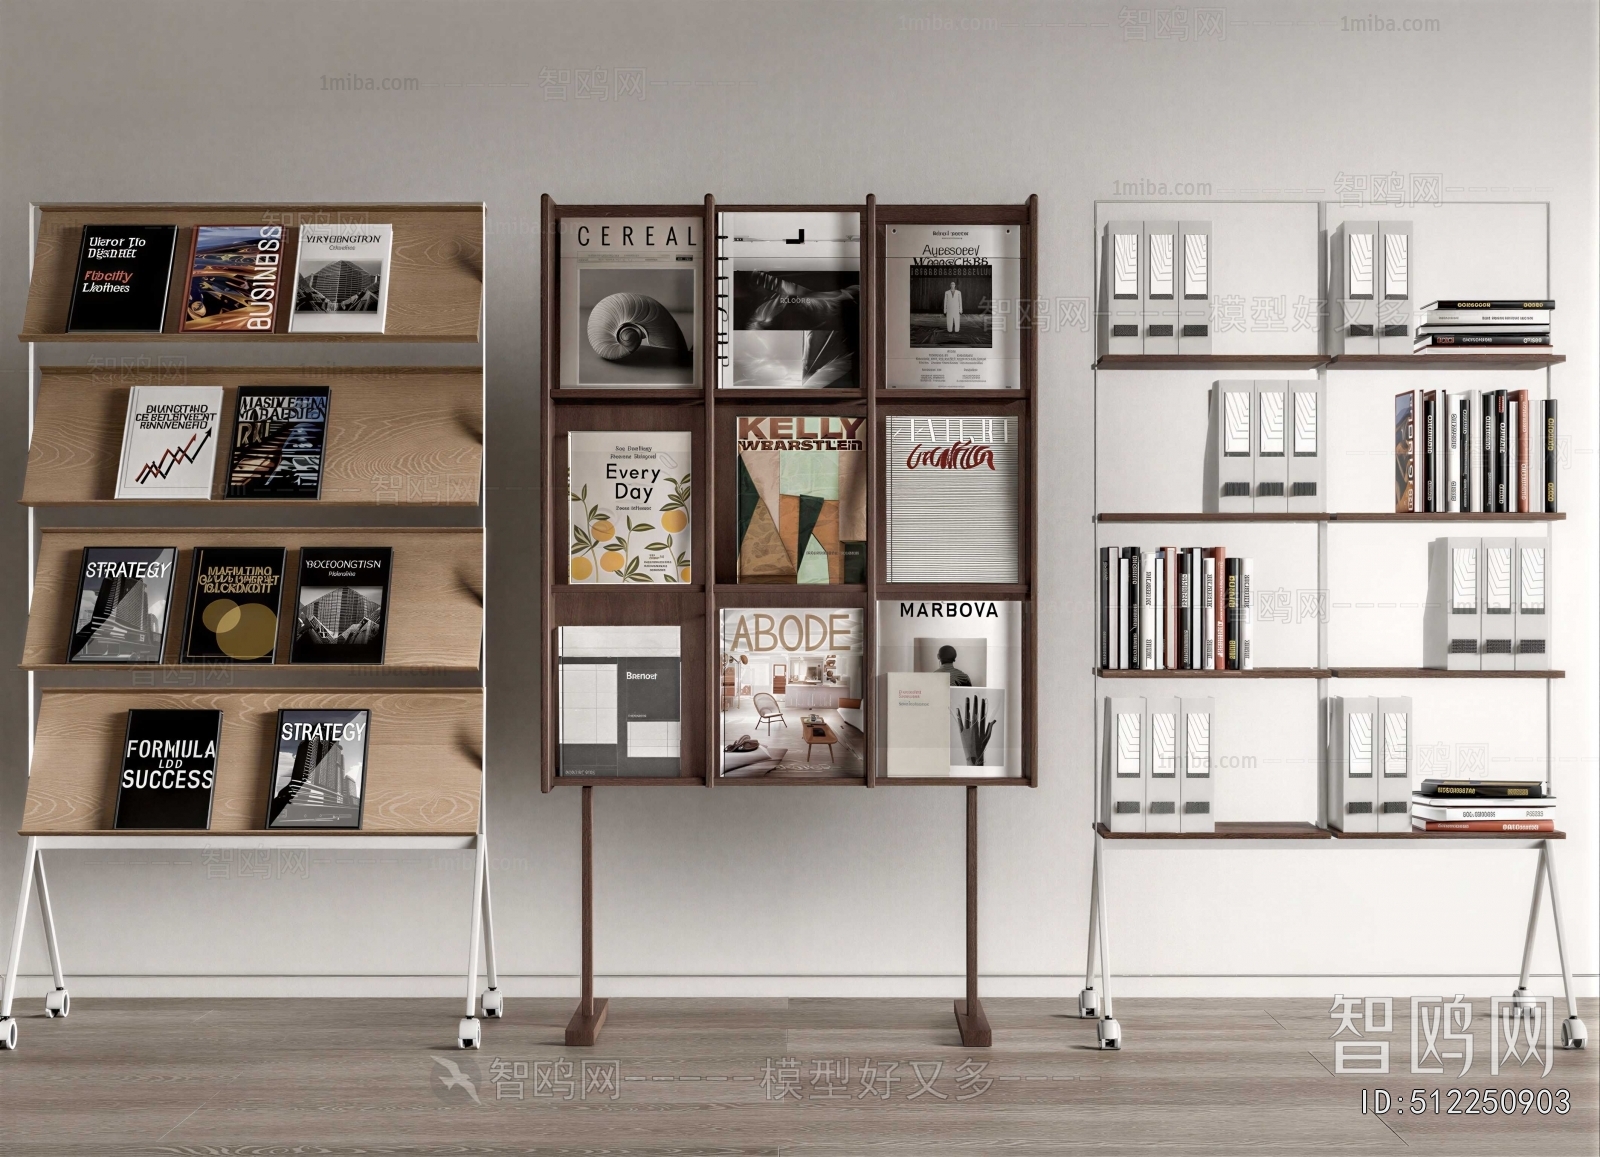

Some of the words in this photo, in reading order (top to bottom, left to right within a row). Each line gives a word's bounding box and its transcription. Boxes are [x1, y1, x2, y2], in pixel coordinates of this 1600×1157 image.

[578, 226, 697, 246] CEREAL
[739, 417, 866, 440] KELLY
[606, 463, 661, 483] Every
[615, 482, 653, 503] Day
[86, 561, 172, 578] STRATEGY
[900, 602, 999, 618] MARBOVA
[730, 613, 851, 652] ABODE
[281, 722, 366, 741] STRATEGY
[126, 739, 216, 758] FORMULA
[122, 769, 213, 789] SUCCESS
